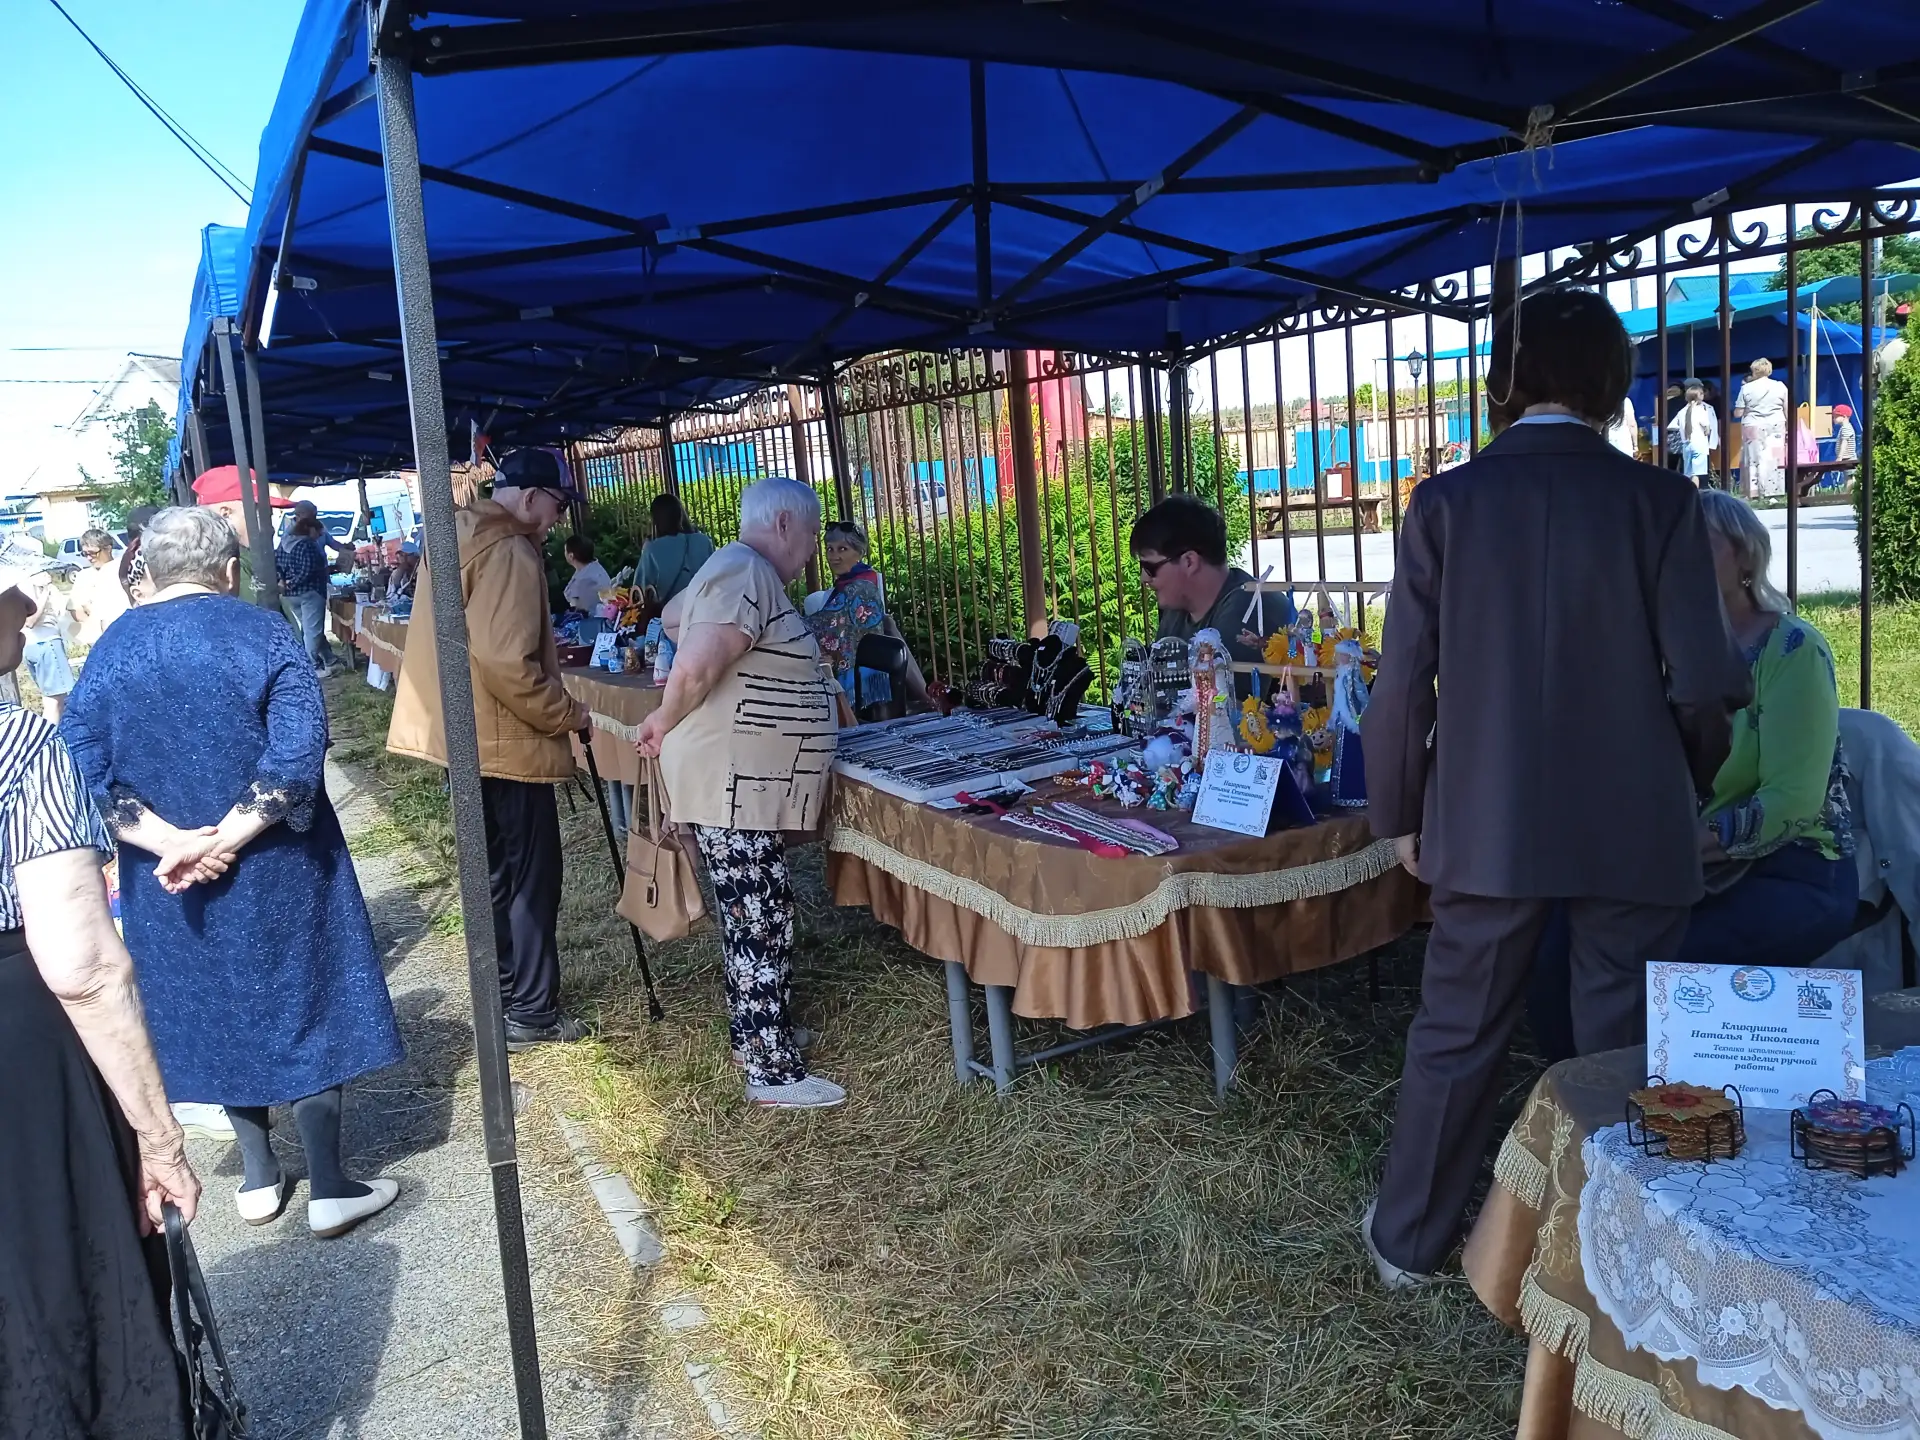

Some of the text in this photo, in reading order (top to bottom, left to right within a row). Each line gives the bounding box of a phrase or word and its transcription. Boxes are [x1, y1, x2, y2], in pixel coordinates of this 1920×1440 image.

[1680, 986, 1697, 998] 95
[1797, 987, 1810, 998] 20
[1721, 1022, 1788, 1034] Кликушина
[1691, 1030, 1820, 1046] Наталья Николаевна
[1713, 1044, 1796, 1056] Техника исполнения:
[1693, 1052, 1818, 1066] гипсовые изделия ручной
[1734, 1062, 1775, 1072] работы
[1738, 1084, 1780, 1095] Неволино
